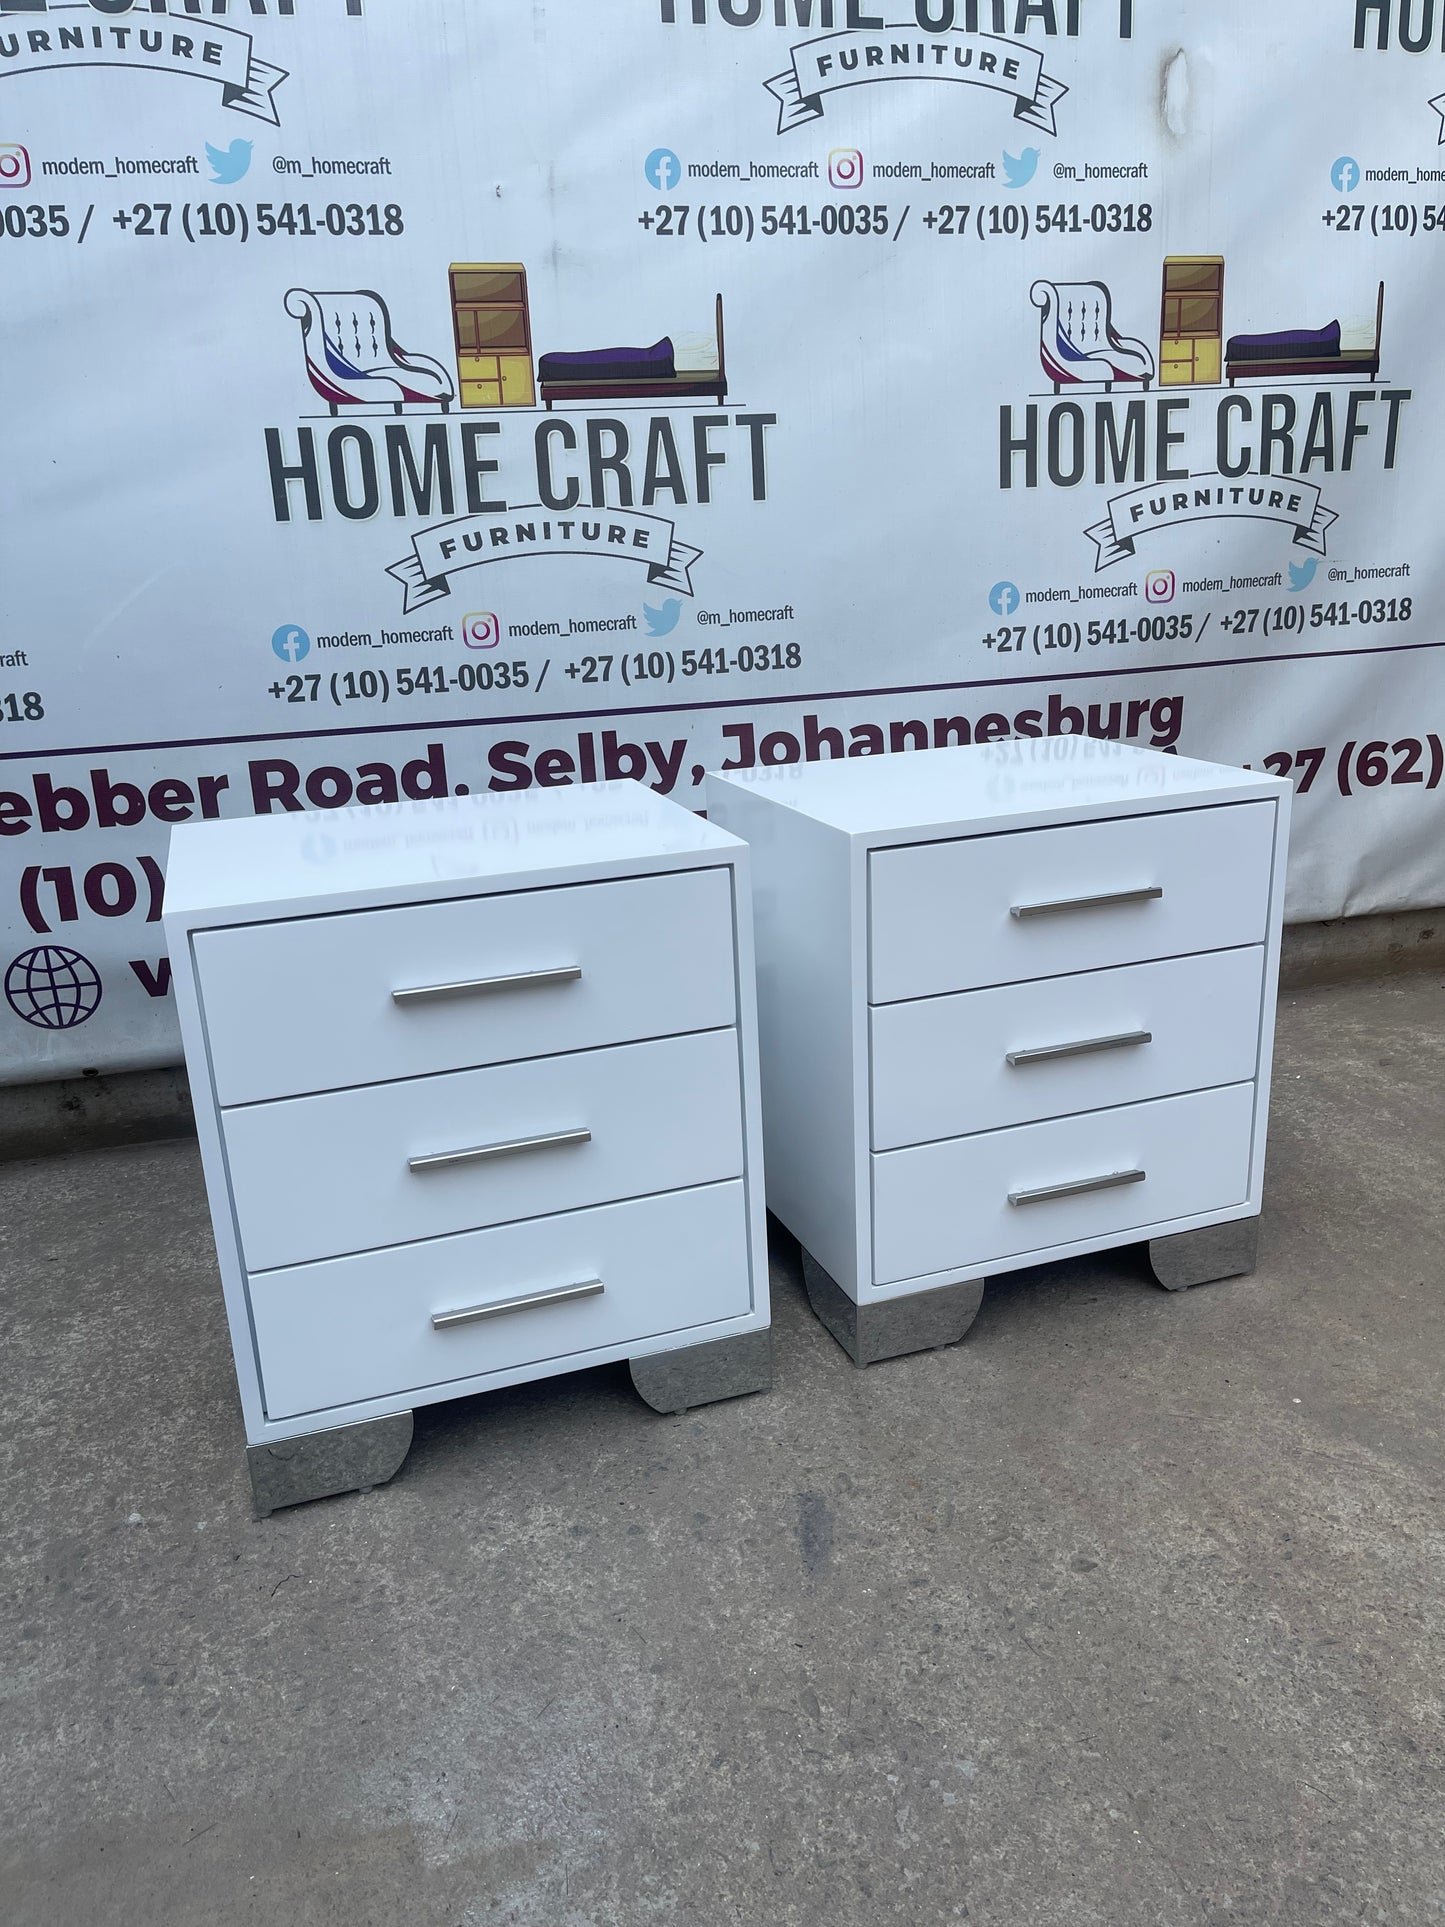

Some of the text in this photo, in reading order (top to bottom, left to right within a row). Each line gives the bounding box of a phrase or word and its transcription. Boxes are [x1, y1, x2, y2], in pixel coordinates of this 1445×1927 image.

[0, 26, 224, 66] URNITURE
[816, 43, 1020, 80] FURNITURE
[42, 156, 392, 178] modern_homecraft @m_homecraft
[688, 161, 1148, 181] modern_homecraft modern_homecraft @m_homecraft
[112, 203, 172, 235] +27
[182, 203, 249, 243] (10)
[256, 203, 404, 236] 541-0318
[638, 205, 689, 235] +27
[698, 205, 754, 242] (10)
[761, 204, 888, 235] 541-0035
[923, 205, 970, 234] +27
[976, 205, 1031, 240] (10)
[1035, 202, 1152, 233] 541-0318
[1322, 205, 1365, 231] +27
[1371, 204, 1417, 237] (10)
[1000, 390, 1412, 489] HOME CRAFT
[264, 413, 777, 522] HOME CRAFT
[1130, 487, 1302, 523] FURNITURE
[439, 521, 650, 560] FURNITURE
[1025, 563, 1411, 604] modern_homecraft modern_homecraft @m_homecraft
[317, 605, 794, 648] modern_homecraft modern_homecraft @m_homecraft
[982, 626, 1026, 652] +27
[1033, 622, 1081, 655] (10)
[1087, 613, 1193, 646] 541-0035
[1220, 608, 1259, 635] +27
[1263, 604, 1305, 637] (10)
[1309, 597, 1412, 627] 541-0318
[268, 674, 321, 703] +27
[330, 670, 389, 706] (10)
[396, 660, 529, 696] 541-0035
[564, 655, 613, 683] +27
[621, 651, 675, 686] (10)
[681, 642, 801, 676] 541-0318
[0, 692, 44, 722] 18
[488, 730, 706, 795] Selby,
[721, 694, 1184, 769] Johannesburg
[1337, 734, 1444, 796] (62)
[20, 856, 165, 933] (10)
